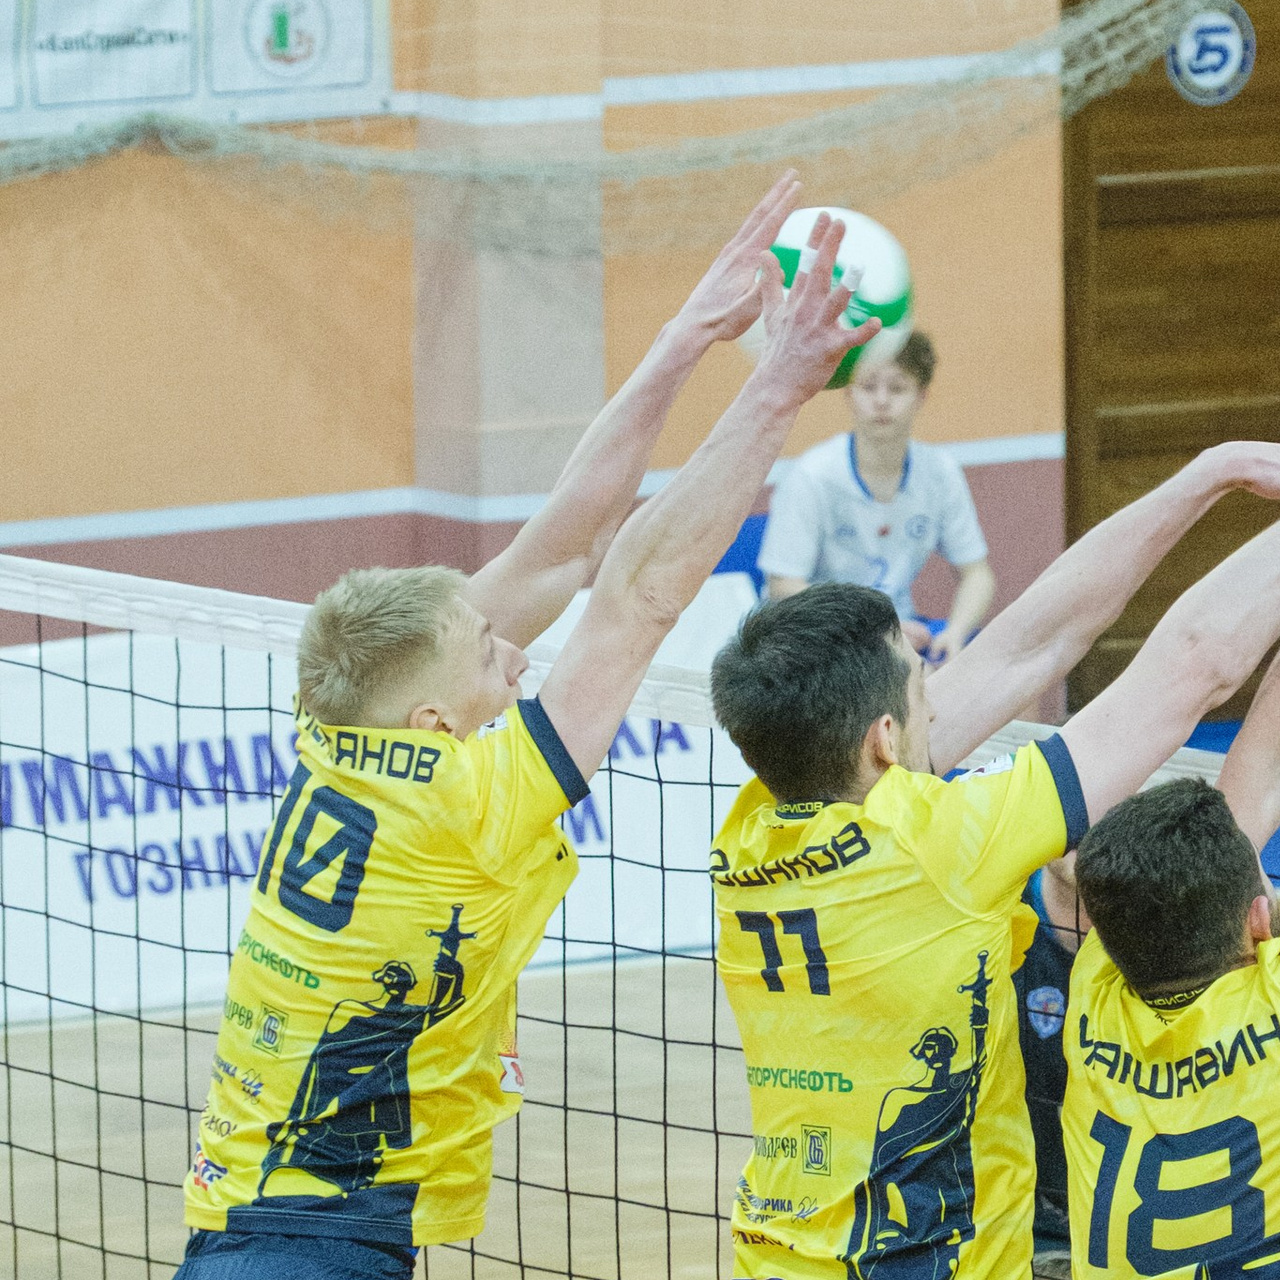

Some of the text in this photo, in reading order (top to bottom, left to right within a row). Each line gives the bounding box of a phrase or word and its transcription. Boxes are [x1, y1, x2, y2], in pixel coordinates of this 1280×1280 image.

[1188, 25, 1231, 74] 5
[257, 758, 378, 933] 10
[735, 908, 831, 996] 11
[1087, 1109, 1266, 1277] 18
